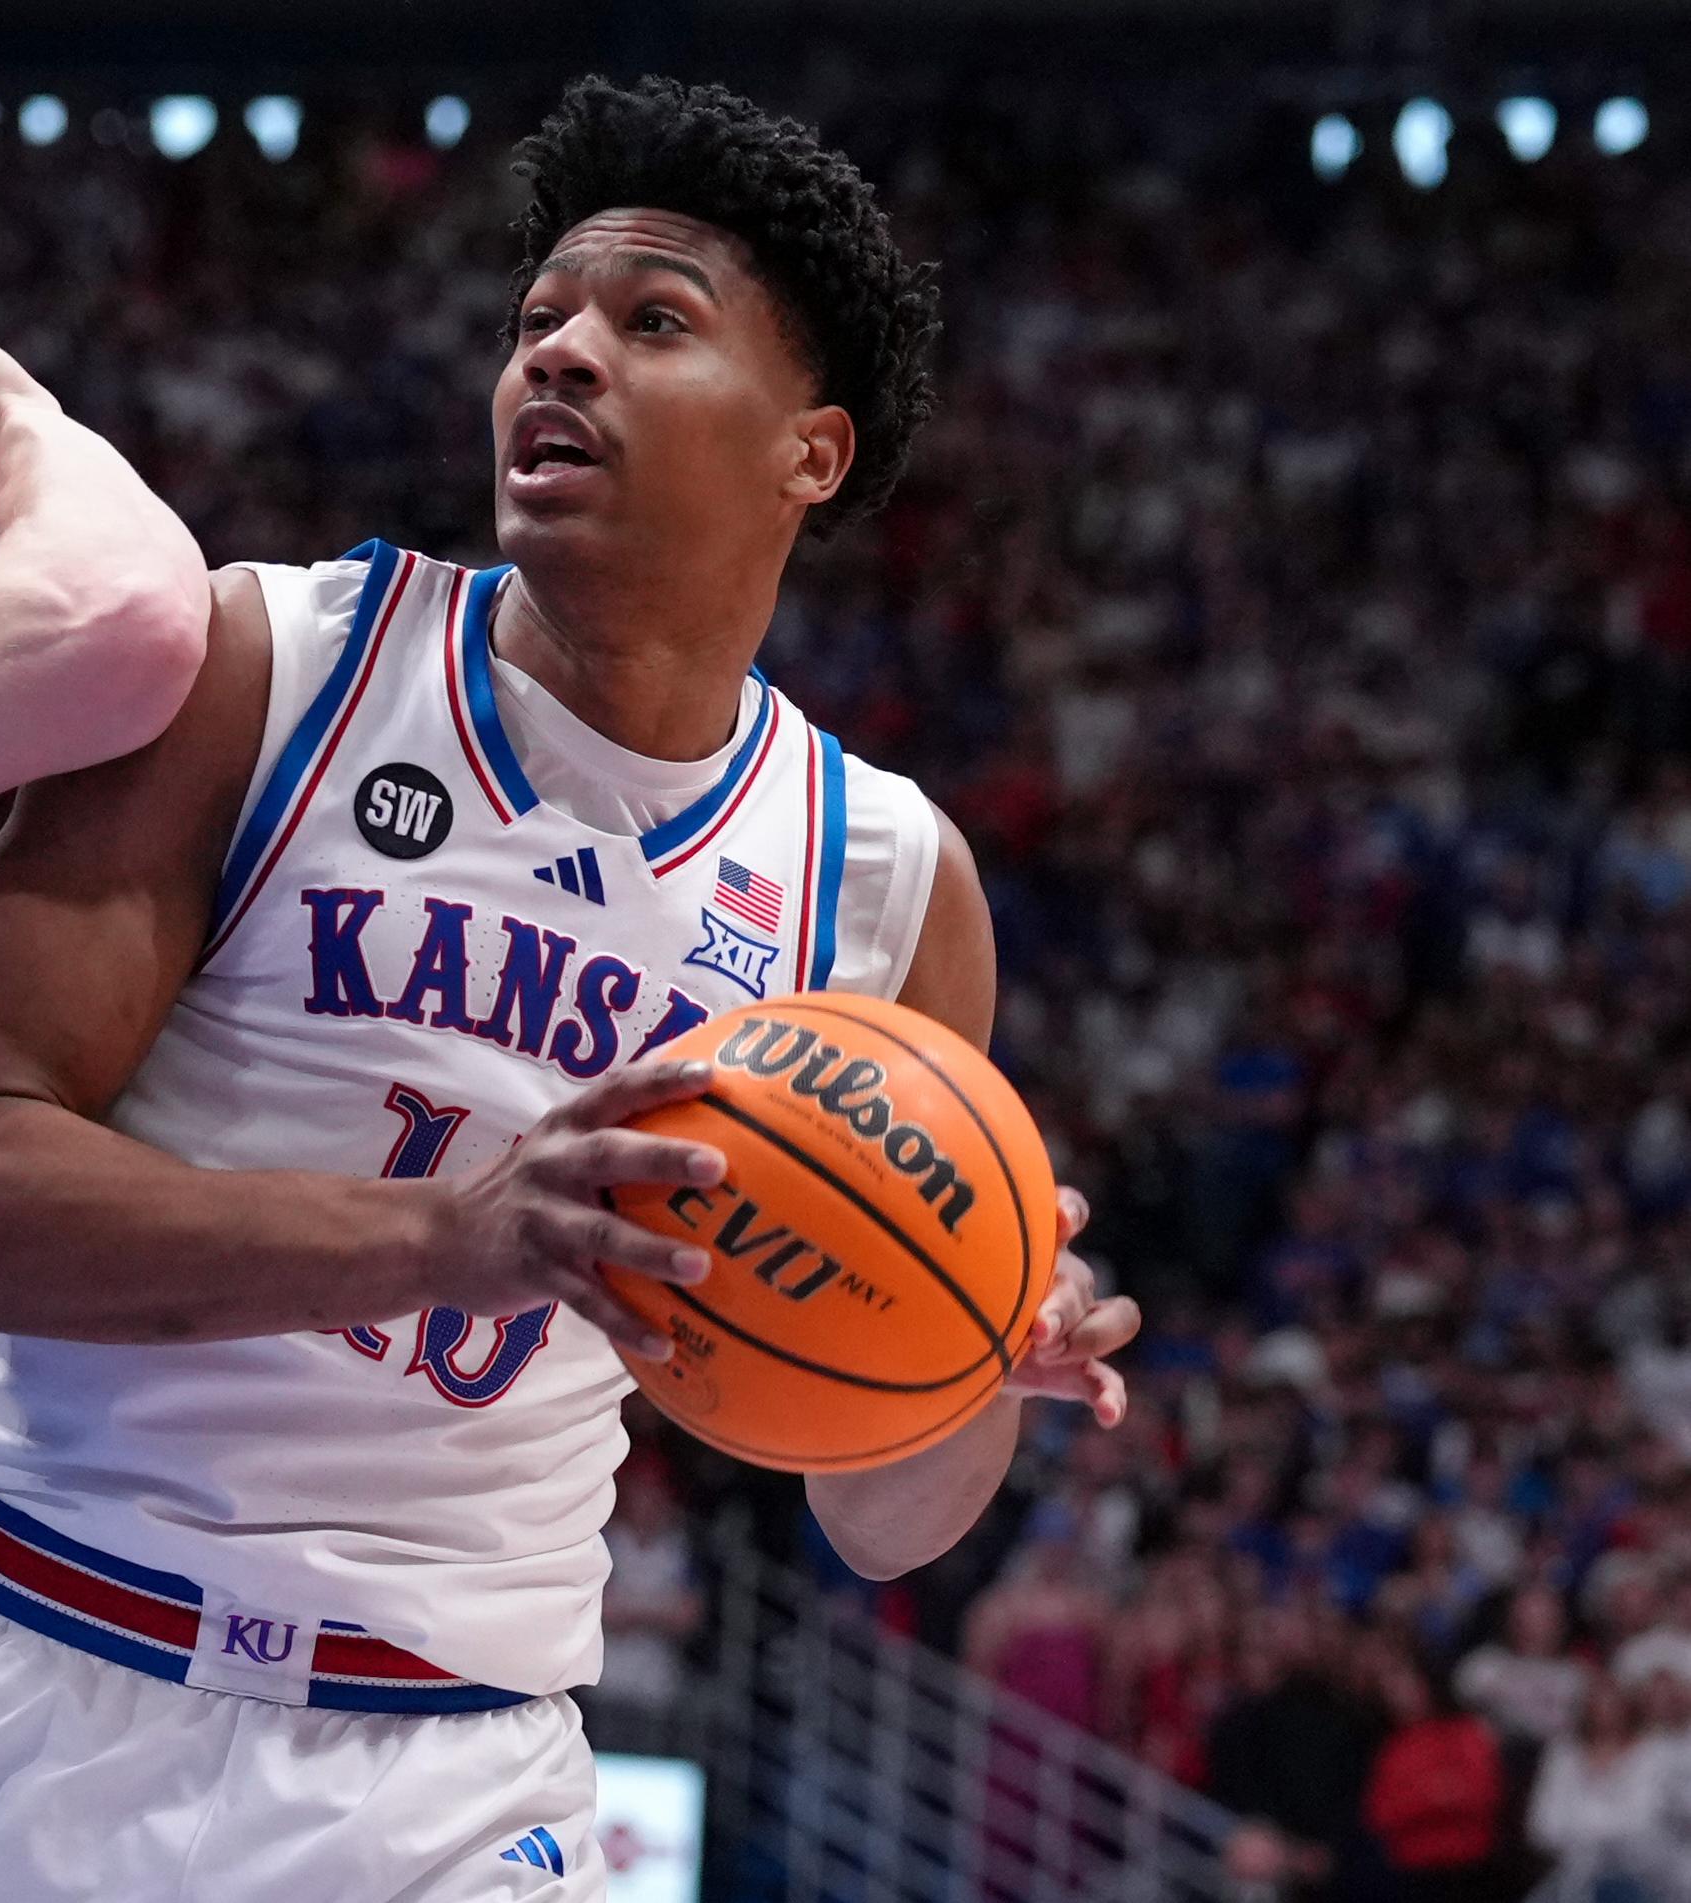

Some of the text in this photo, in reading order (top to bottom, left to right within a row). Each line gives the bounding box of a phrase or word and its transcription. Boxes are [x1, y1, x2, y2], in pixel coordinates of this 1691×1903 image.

[364, 777, 443, 843] SW
[300, 886, 711, 1079] KANS
[714, 1017, 978, 1236] Wilson
[220, 1614, 299, 1665] KU
